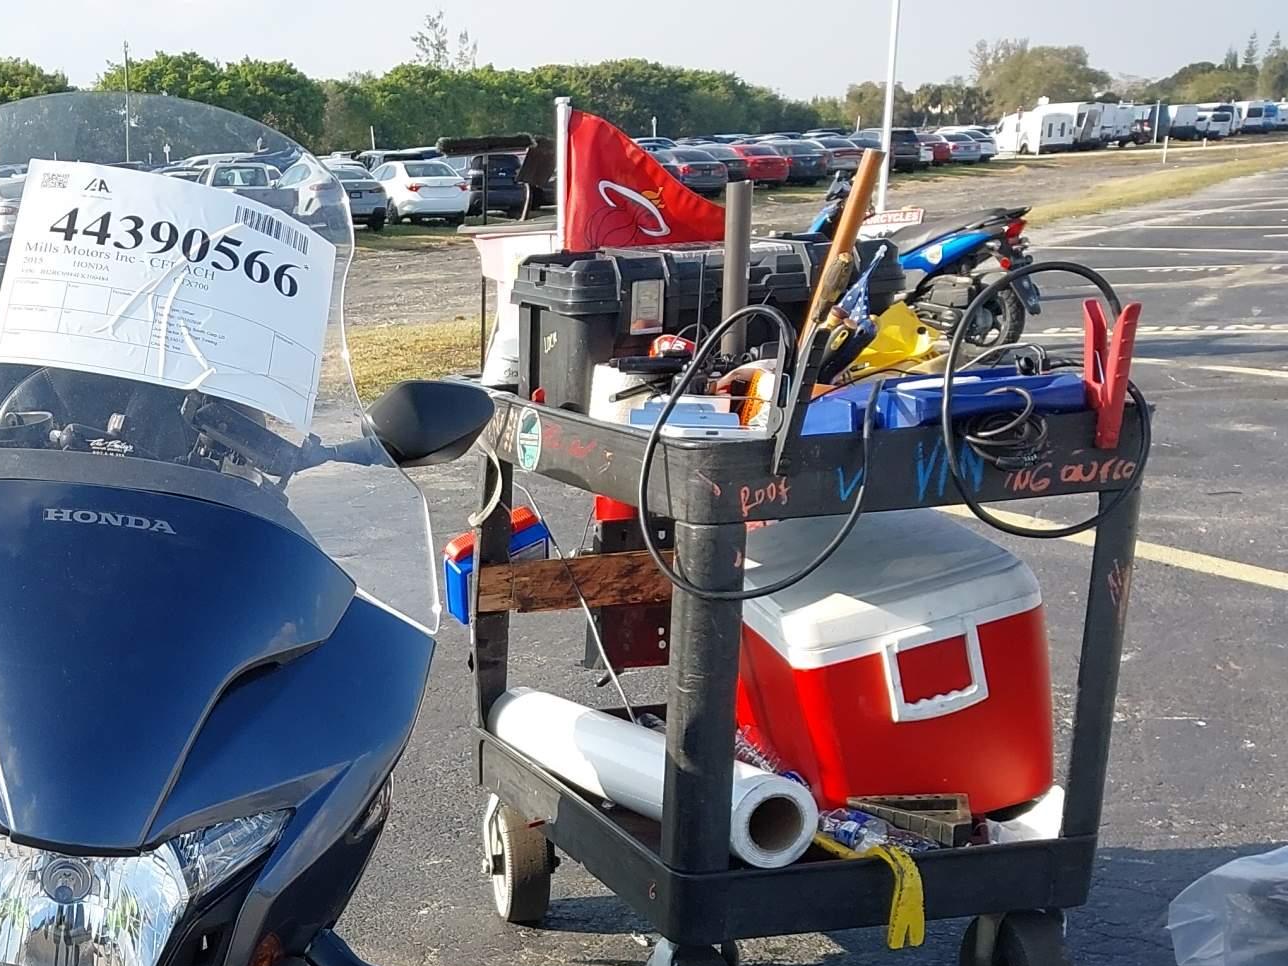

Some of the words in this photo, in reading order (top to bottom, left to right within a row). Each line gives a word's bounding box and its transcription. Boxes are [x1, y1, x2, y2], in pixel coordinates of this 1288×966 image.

[23, 256, 44, 265] 2015
[72, 260, 110, 272] HONDA
[25, 241, 59, 254] Mills
[63, 245, 111, 260] Motors
[115, 250, 136, 264] Inc
[49, 207, 302, 298] 44390566
[43, 508, 177, 536] HONDA
